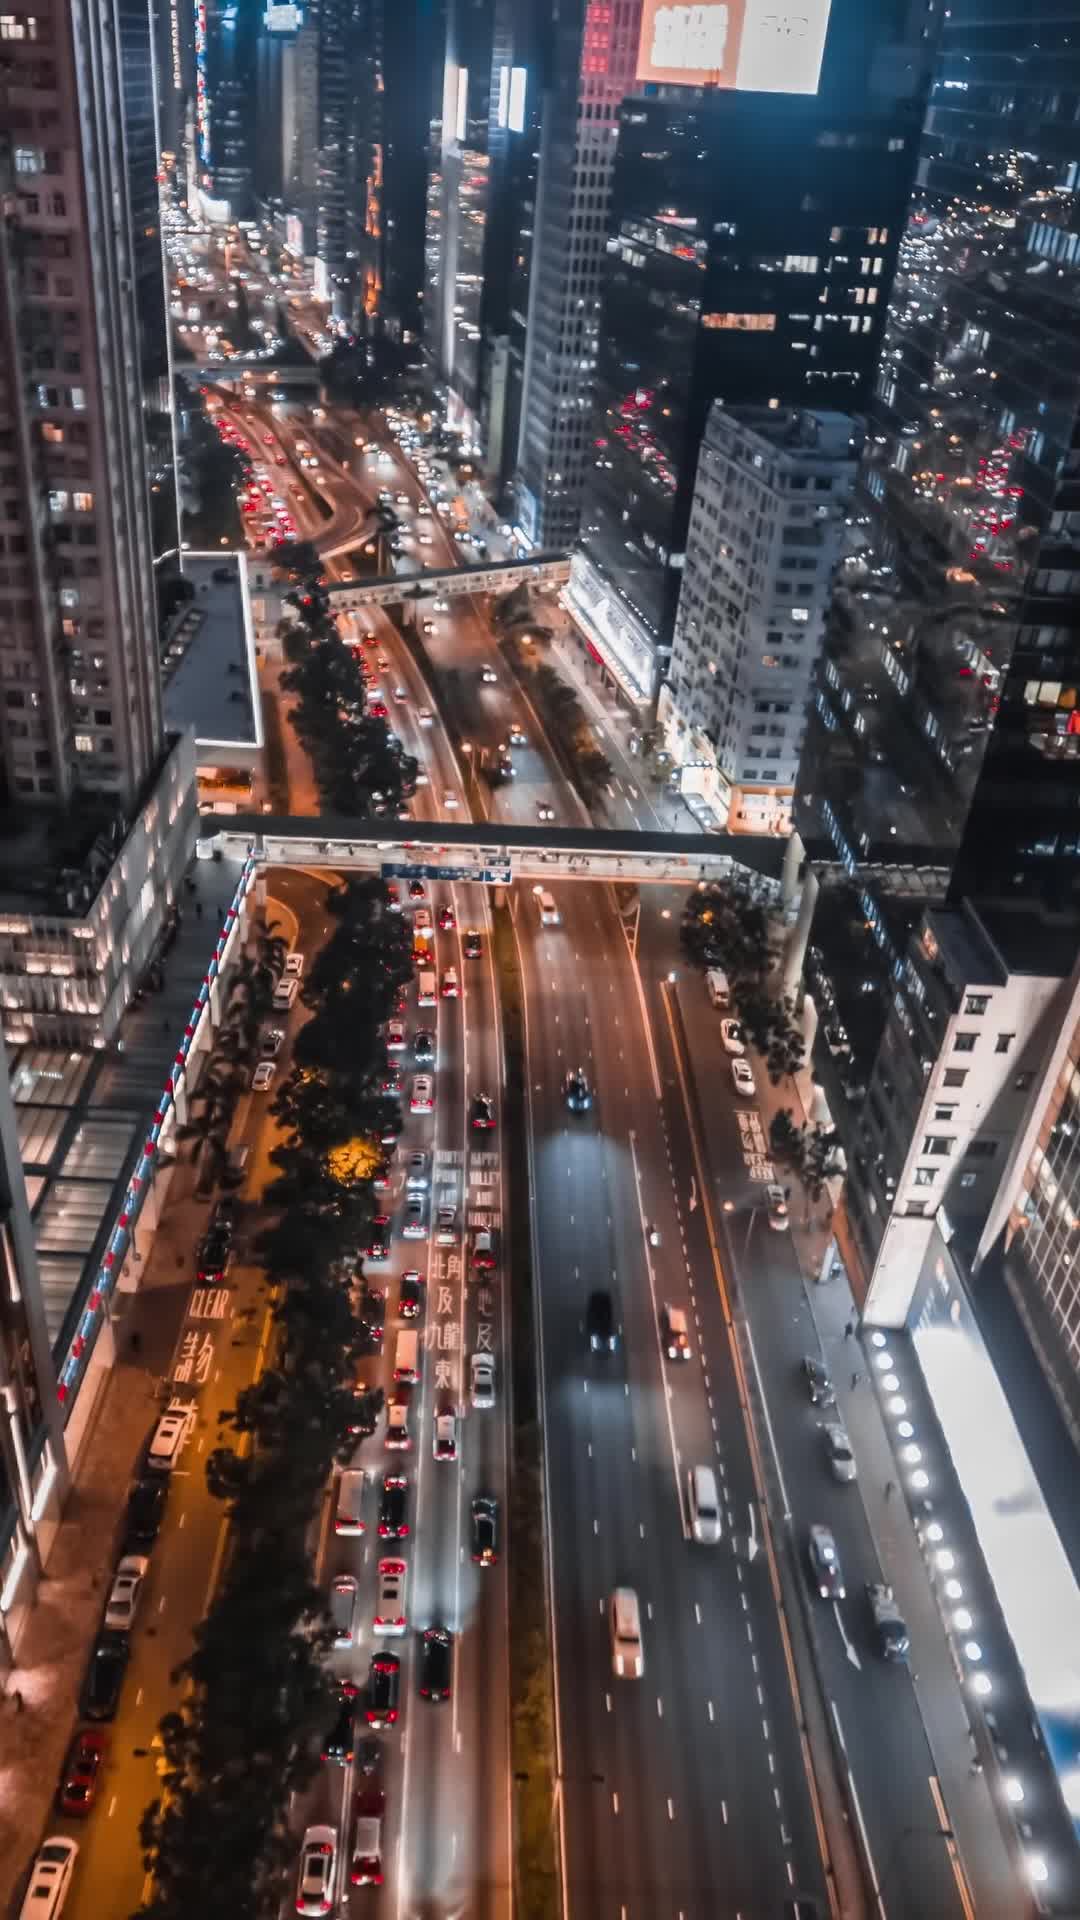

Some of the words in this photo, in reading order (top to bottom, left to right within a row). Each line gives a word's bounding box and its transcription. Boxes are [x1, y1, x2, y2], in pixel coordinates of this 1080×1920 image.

[431, 1254, 461, 1279] 北角
[189, 1289, 230, 1319] CLEAR
[436, 1287, 453, 1314] 及
[428, 1322, 461, 1350] 九龍
[476, 1323, 492, 1351] 及
[173, 1331, 214, 1382] 請勿
[435, 1360, 451, 1389] 東
